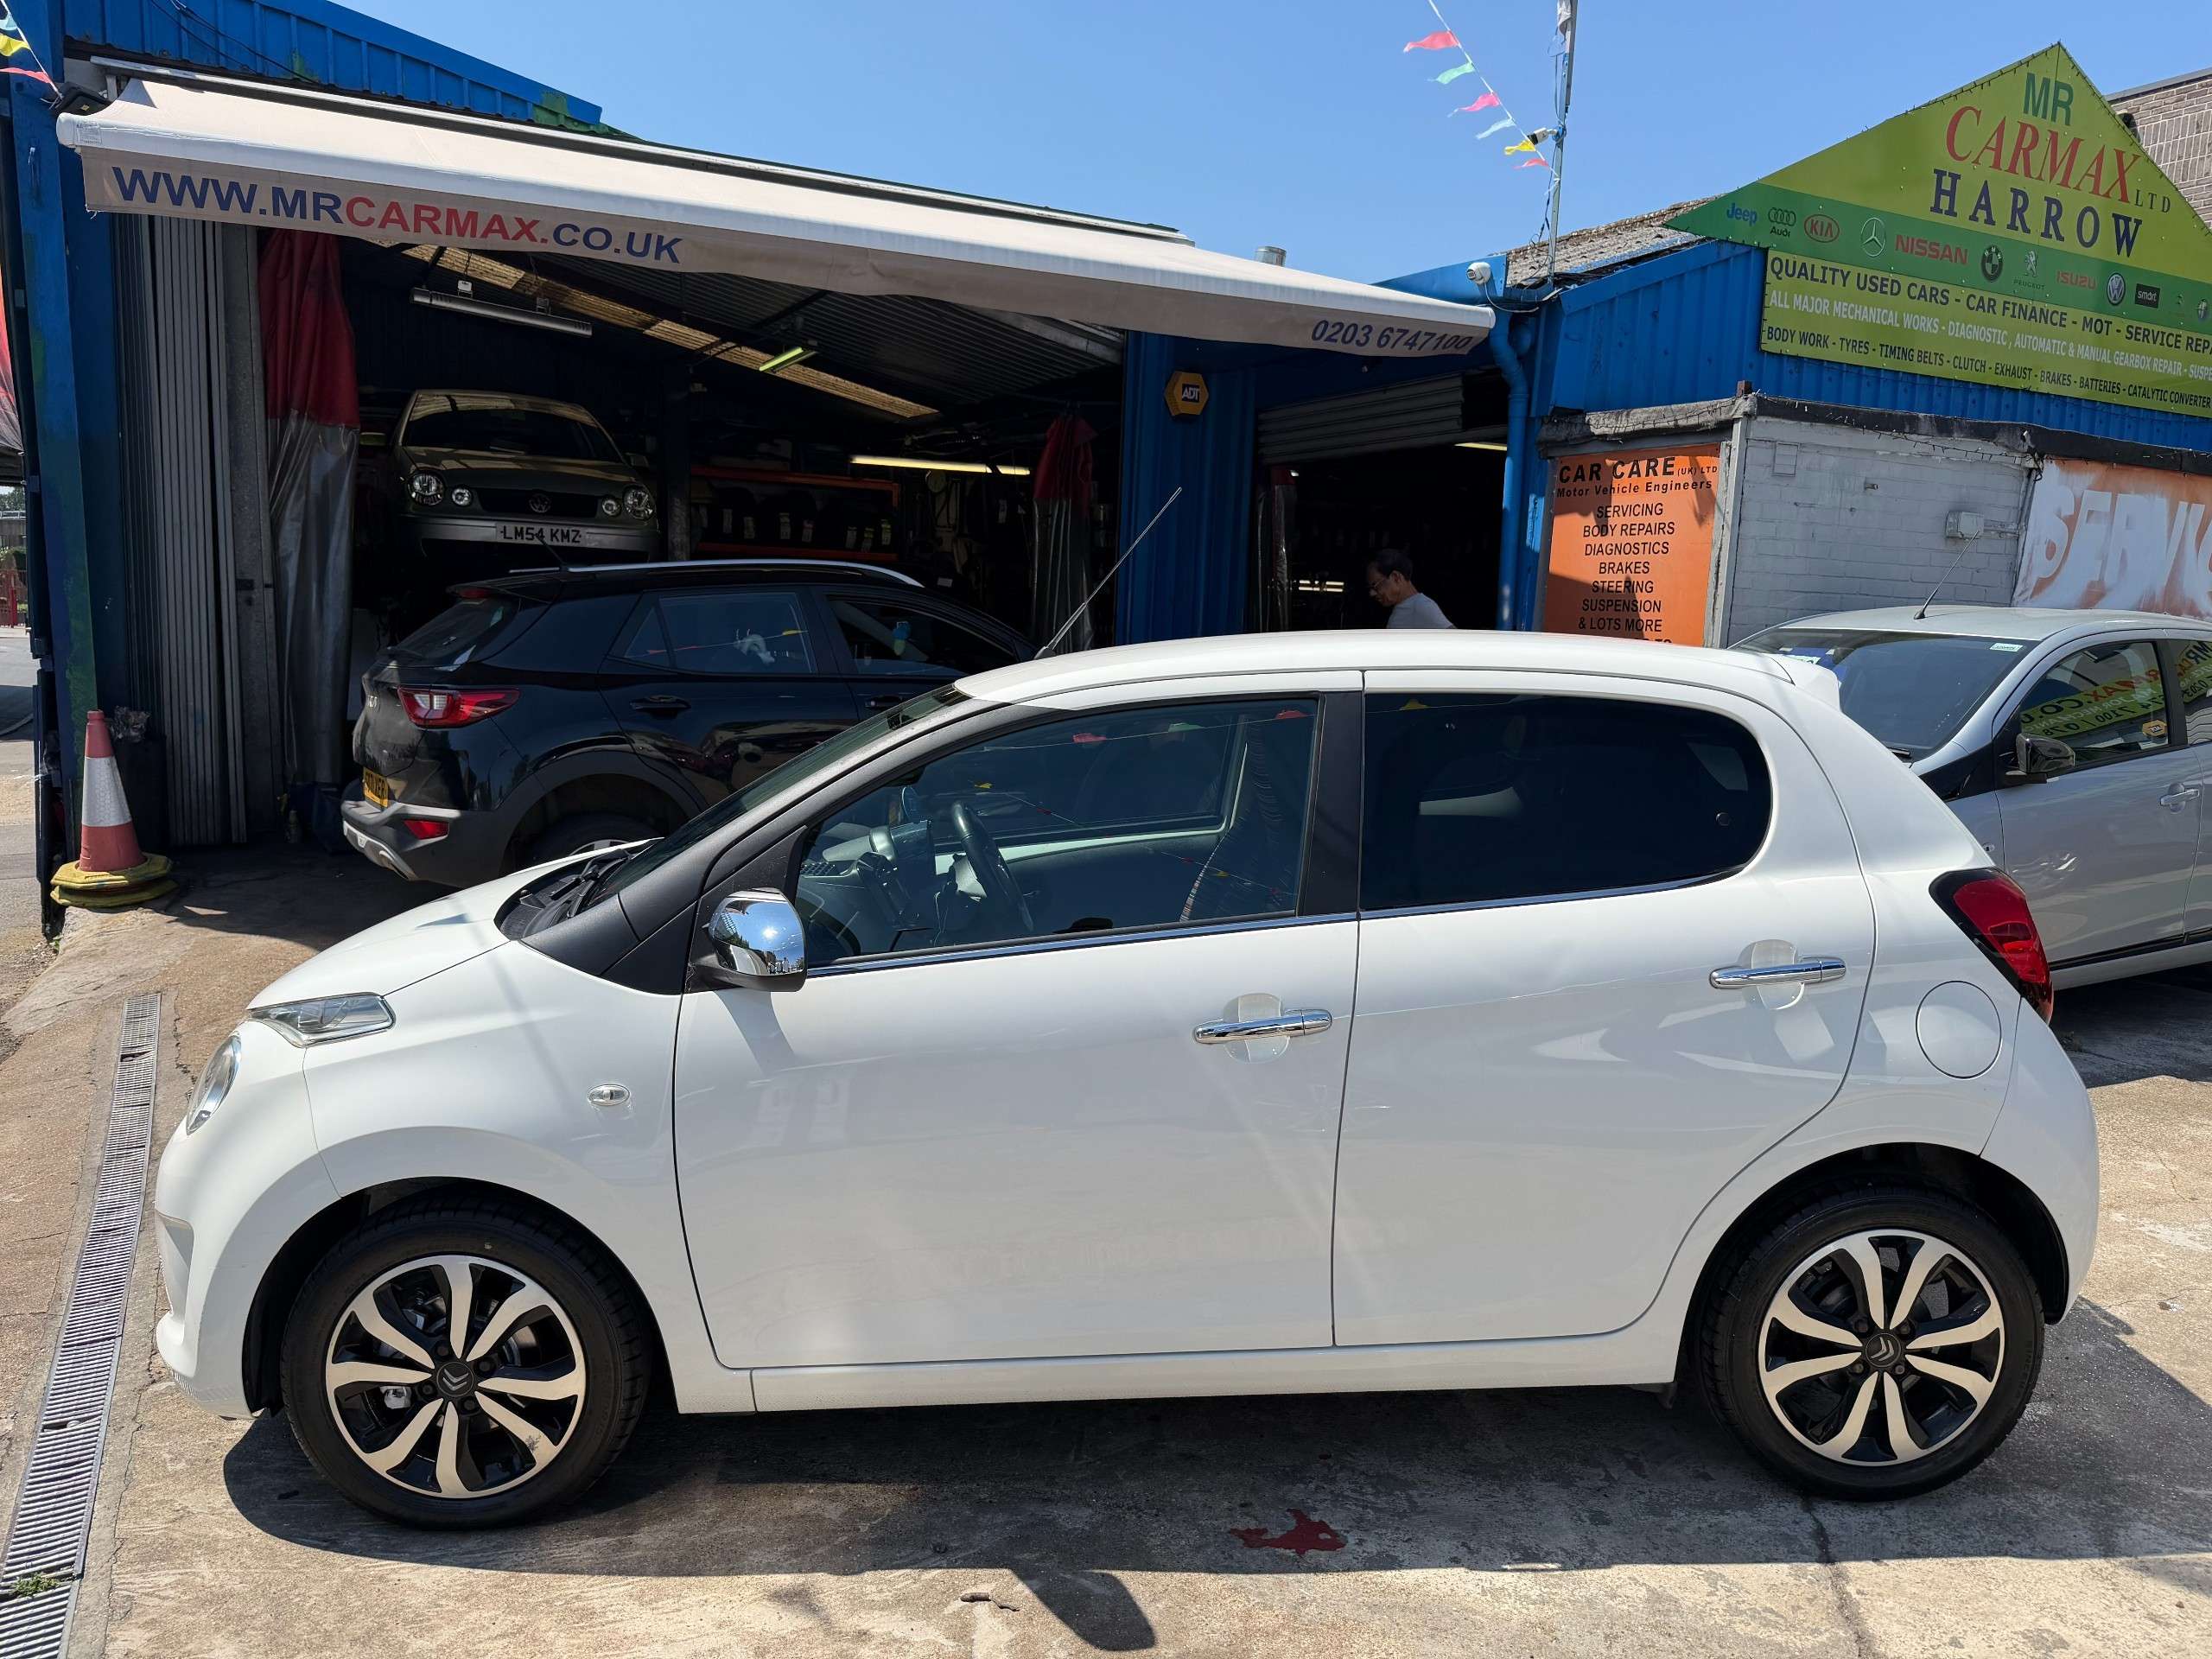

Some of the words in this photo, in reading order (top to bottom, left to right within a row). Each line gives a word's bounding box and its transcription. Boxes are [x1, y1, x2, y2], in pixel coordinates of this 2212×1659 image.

[2023, 72, 2074, 126] MR
[1946, 105, 2141, 203] CARMAX
[2135, 189, 2171, 213] LTD
[111, 166, 683, 264] WWW.MRCARMAX.CO.UK
[1929, 168, 2143, 257] HARROW
[1726, 202, 1758, 226] Jeep
[1770, 226, 1791, 238] Audi
[1810, 218, 1834, 238] KIA
[1895, 234, 1968, 265] NISSAN
[2013, 278, 2045, 290] PEUGEOT
[2056, 270, 2096, 290] ISUZU
[2137, 290, 2158, 302] smart
[1770, 257, 1851, 288] QUALITY
[1856, 272, 1902, 296] USED
[1907, 282, 1950, 306] CARS
[1966, 294, 1997, 315] CAR
[2002, 301, 2068, 328] FINANCE
[2082, 316, 2113, 336] MOT
[2125, 325, 2182, 349] SERVICE
[2185, 336, 2212, 355] REP
[1312, 320, 1374, 347] 0203
[1376, 327, 1473, 351] 6747100
[1770, 289, 1789, 308] ALL
[1793, 294, 1829, 316] MAJOR
[1833, 302, 1900, 327] MECHANICAL
[1903, 313, 1940, 334] WORKS
[2014, 334, 2067, 356] AUTOMATIC
[2068, 346, 2075, 358] &
[2076, 345, 2112, 364] MANUAL
[2113, 351, 2152, 371] GEARBOX
[2152, 358, 2183, 377] REPAIR
[1767, 326, 1796, 344] BODY
[1799, 331, 1830, 349] WORK
[1840, 338, 1870, 355] TYRES
[1878, 343, 1915, 362] TIMING
[1916, 350, 1945, 366] BELTS
[1953, 355, 1986, 373] CLUTCH
[1994, 362, 2032, 381] EXHAUST
[2040, 370, 2072, 387] BRAKES
[2079, 376, 2121, 395] BATTERIES
[2127, 384, 2168, 402] CATALYTIC
[1181, 386, 1199, 401] ADT
[1559, 462, 1602, 484] CAR
[1612, 456, 1675, 480] CARE
[1677, 467, 1697, 477] (UK)
[1700, 466, 1718, 474] LTD
[1557, 486, 1589, 498] Motor
[1593, 482, 1639, 496] Vehicle
[1645, 480, 1713, 495] Engineers
[1597, 503, 1663, 518] SERVICING
[503, 524, 546, 542] LM54
[550, 527, 582, 543] KMZ
[1583, 524, 1617, 537] BODY
[1620, 522, 1675, 537] REPAIRS
[1584, 542, 1669, 556] DIAGNOSTICS
[1599, 562, 1650, 575] BRAKES
[1592, 581, 1654, 594] STEERING
[1582, 600, 1662, 613] SUSPENSION
[1578, 618, 1586, 630] &
[1590, 618, 1622, 631] LOTS
[1624, 619, 1662, 632] MORE
